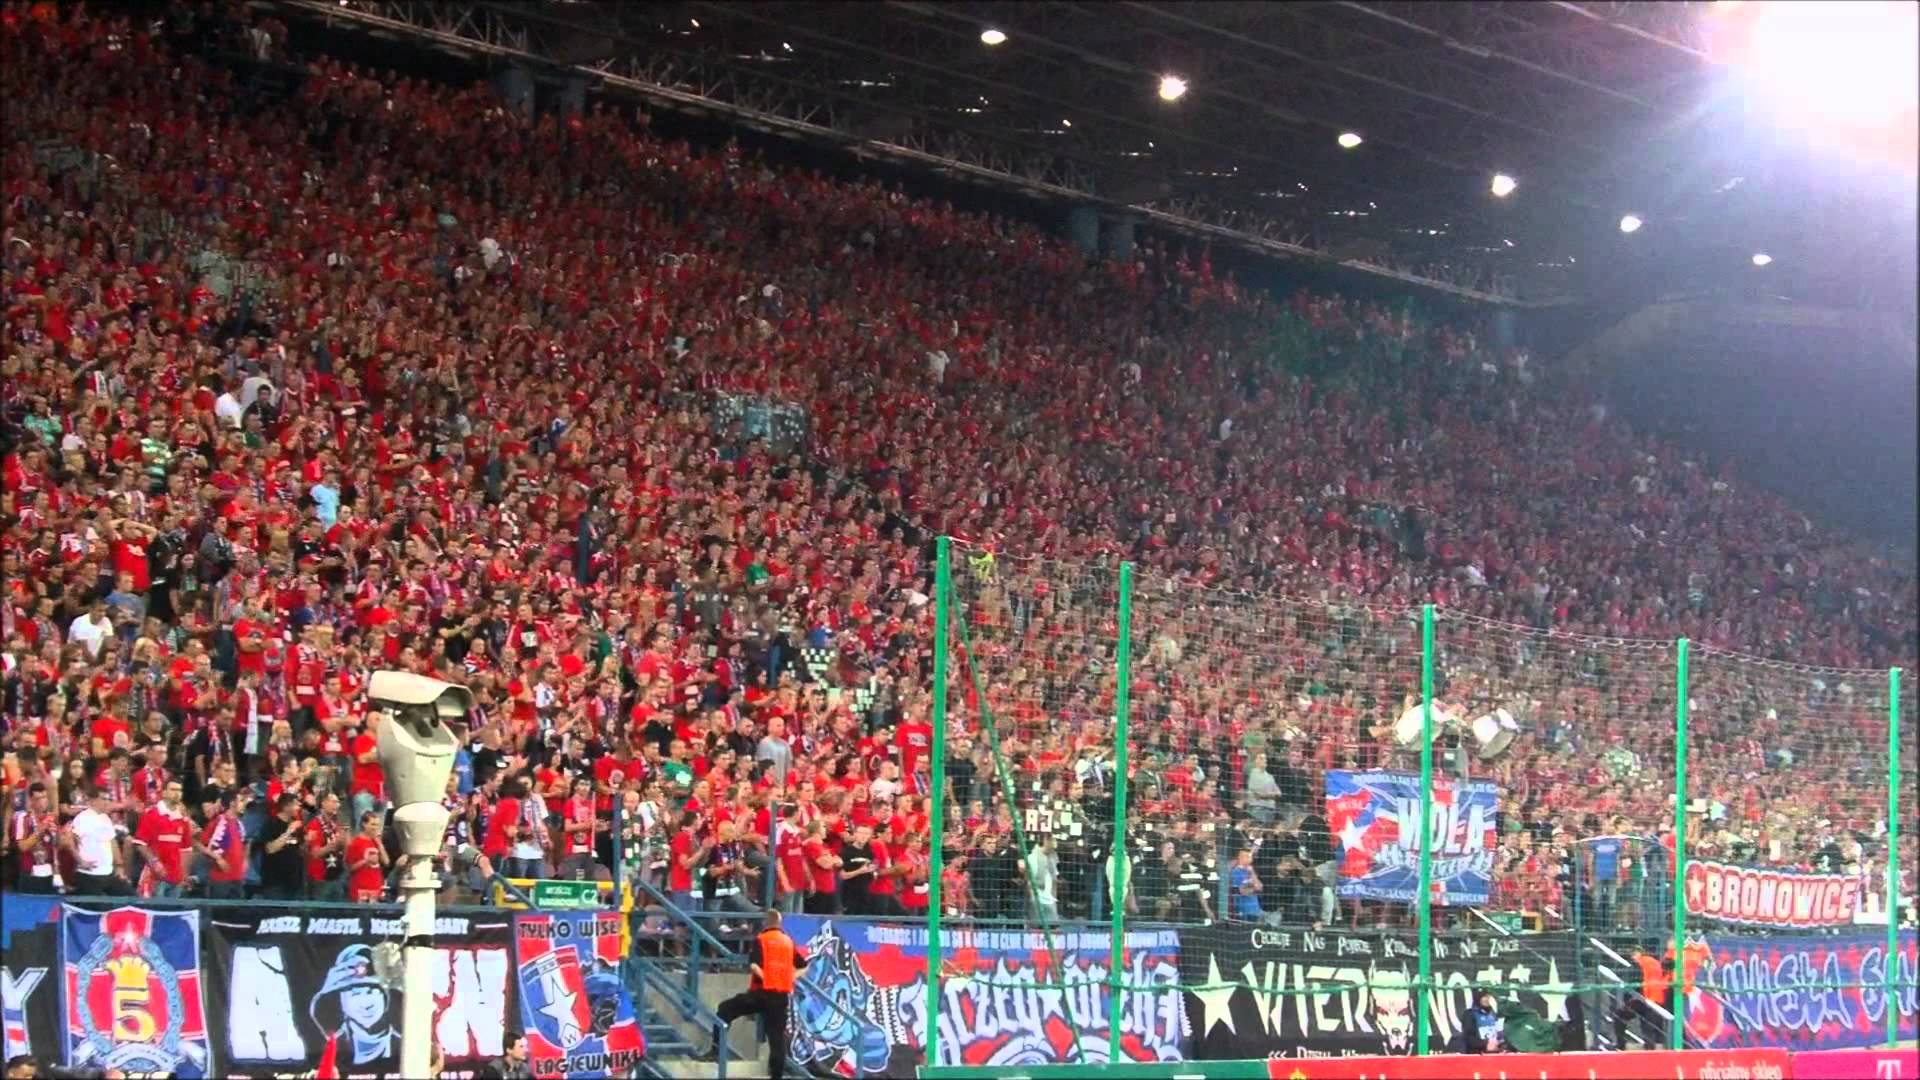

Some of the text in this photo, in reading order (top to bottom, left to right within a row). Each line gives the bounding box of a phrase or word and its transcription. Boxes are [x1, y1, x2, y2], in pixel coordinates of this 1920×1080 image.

[1705, 872, 1858, 921] BRONOWICE
[519, 921, 571, 938] TYLKO
[112, 985, 155, 1042] 5
